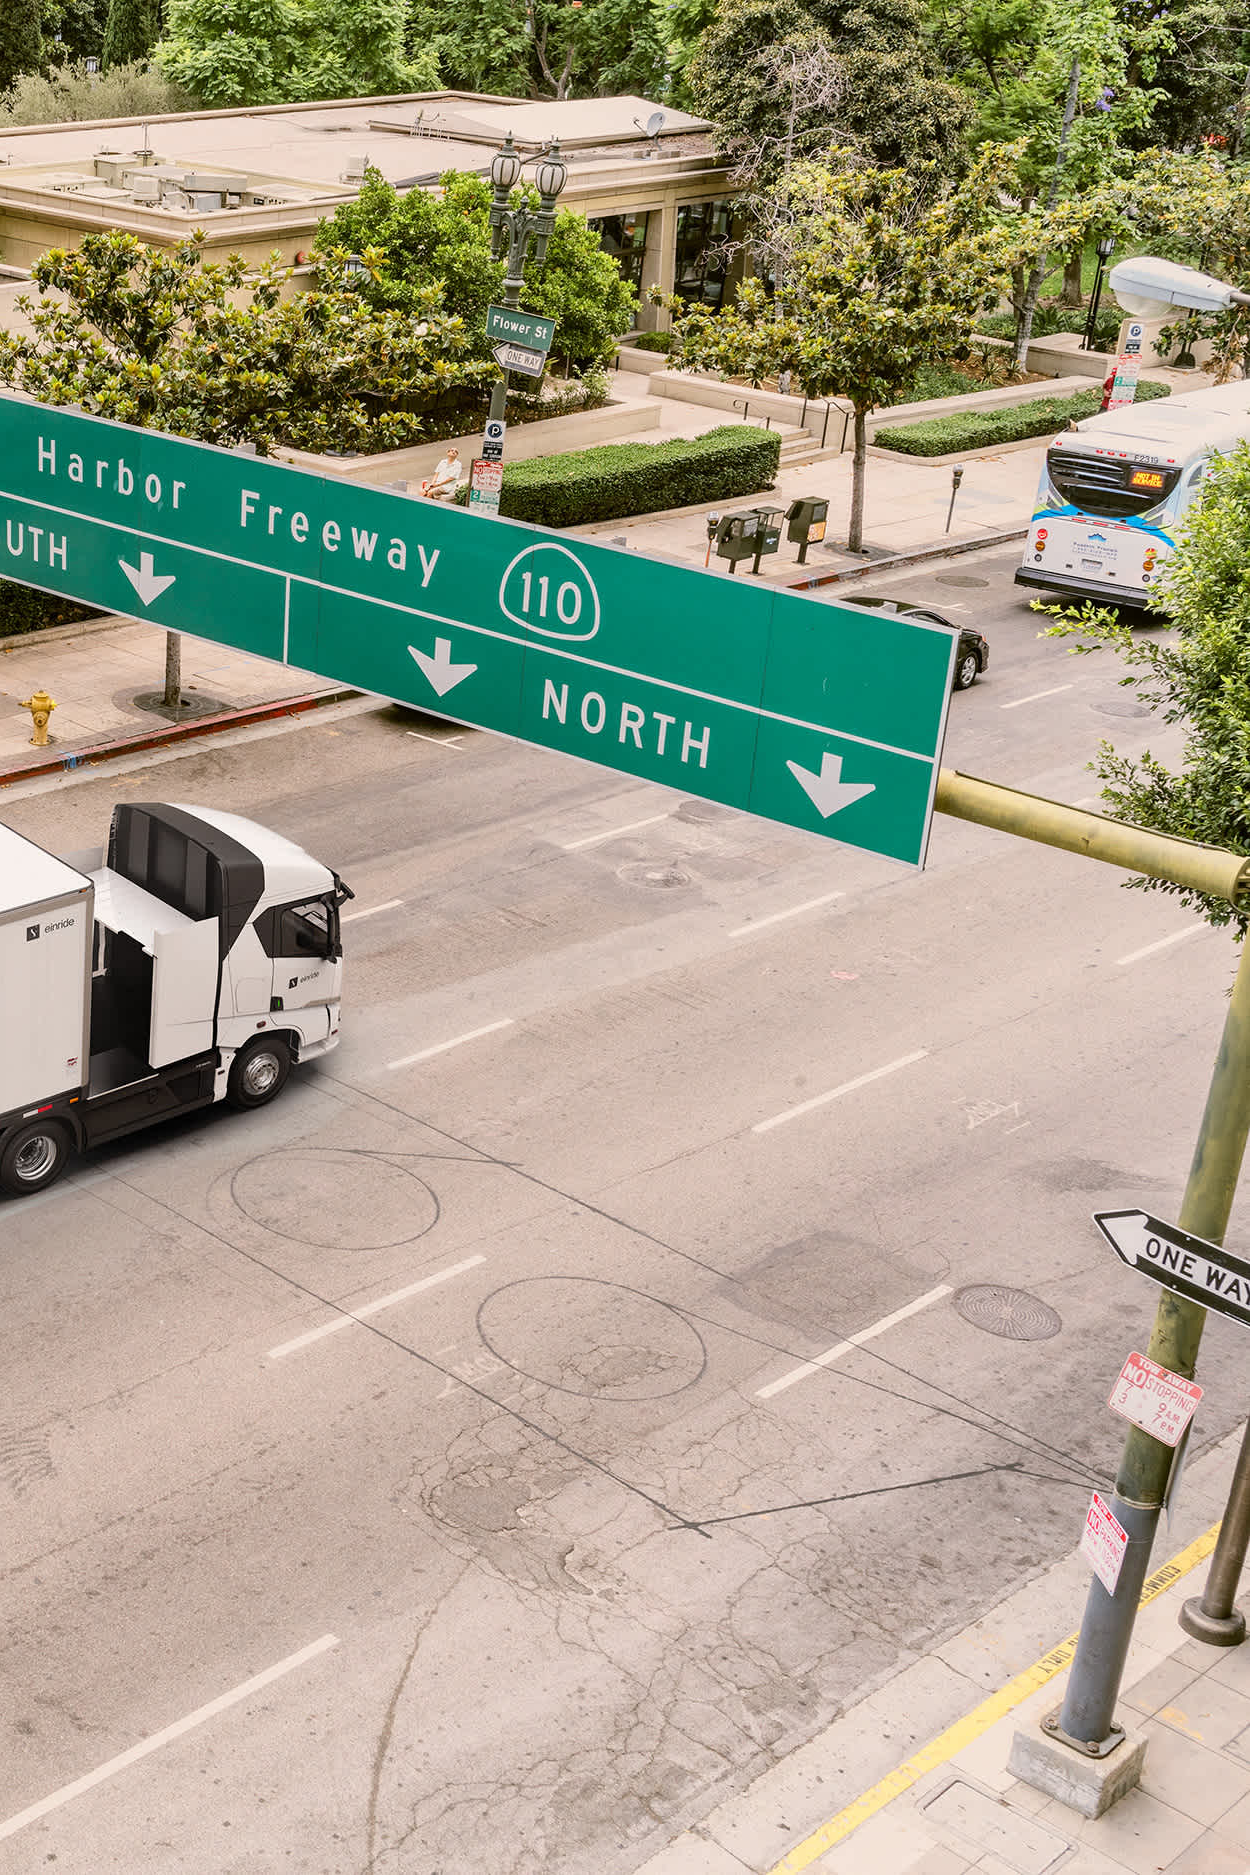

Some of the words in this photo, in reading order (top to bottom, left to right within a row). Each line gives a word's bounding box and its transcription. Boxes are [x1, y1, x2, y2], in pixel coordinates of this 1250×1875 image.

[493, 315, 531, 334] Flower
[534, 326, 547, 339] St
[507, 351, 523, 363] ONE
[524, 355, 540, 367] WAY
[1132, 478, 1162, 488] SERVICE
[1135, 472, 1150, 481] NOT
[473, 491, 479, 499] 2
[38, 436, 186, 509] Harbor
[240, 489, 441, 588] Freeway
[522, 571, 582, 624] 110
[542, 679, 711, 768] NORTH
[44, 918, 75, 934] einride
[1146, 1237, 1197, 1278] ONE
[1123, 1363, 1148, 1386] NO
[1145, 1377, 1194, 1412] STOPPING
[1139, 1357, 1162, 1375] TOW
[1165, 1372, 1193, 1394] AWAY
[1118, 1392, 1128, 1404] 3
[1088, 1509, 1101, 1533] NO
[1141, 1564, 1181, 1600] COMMER
